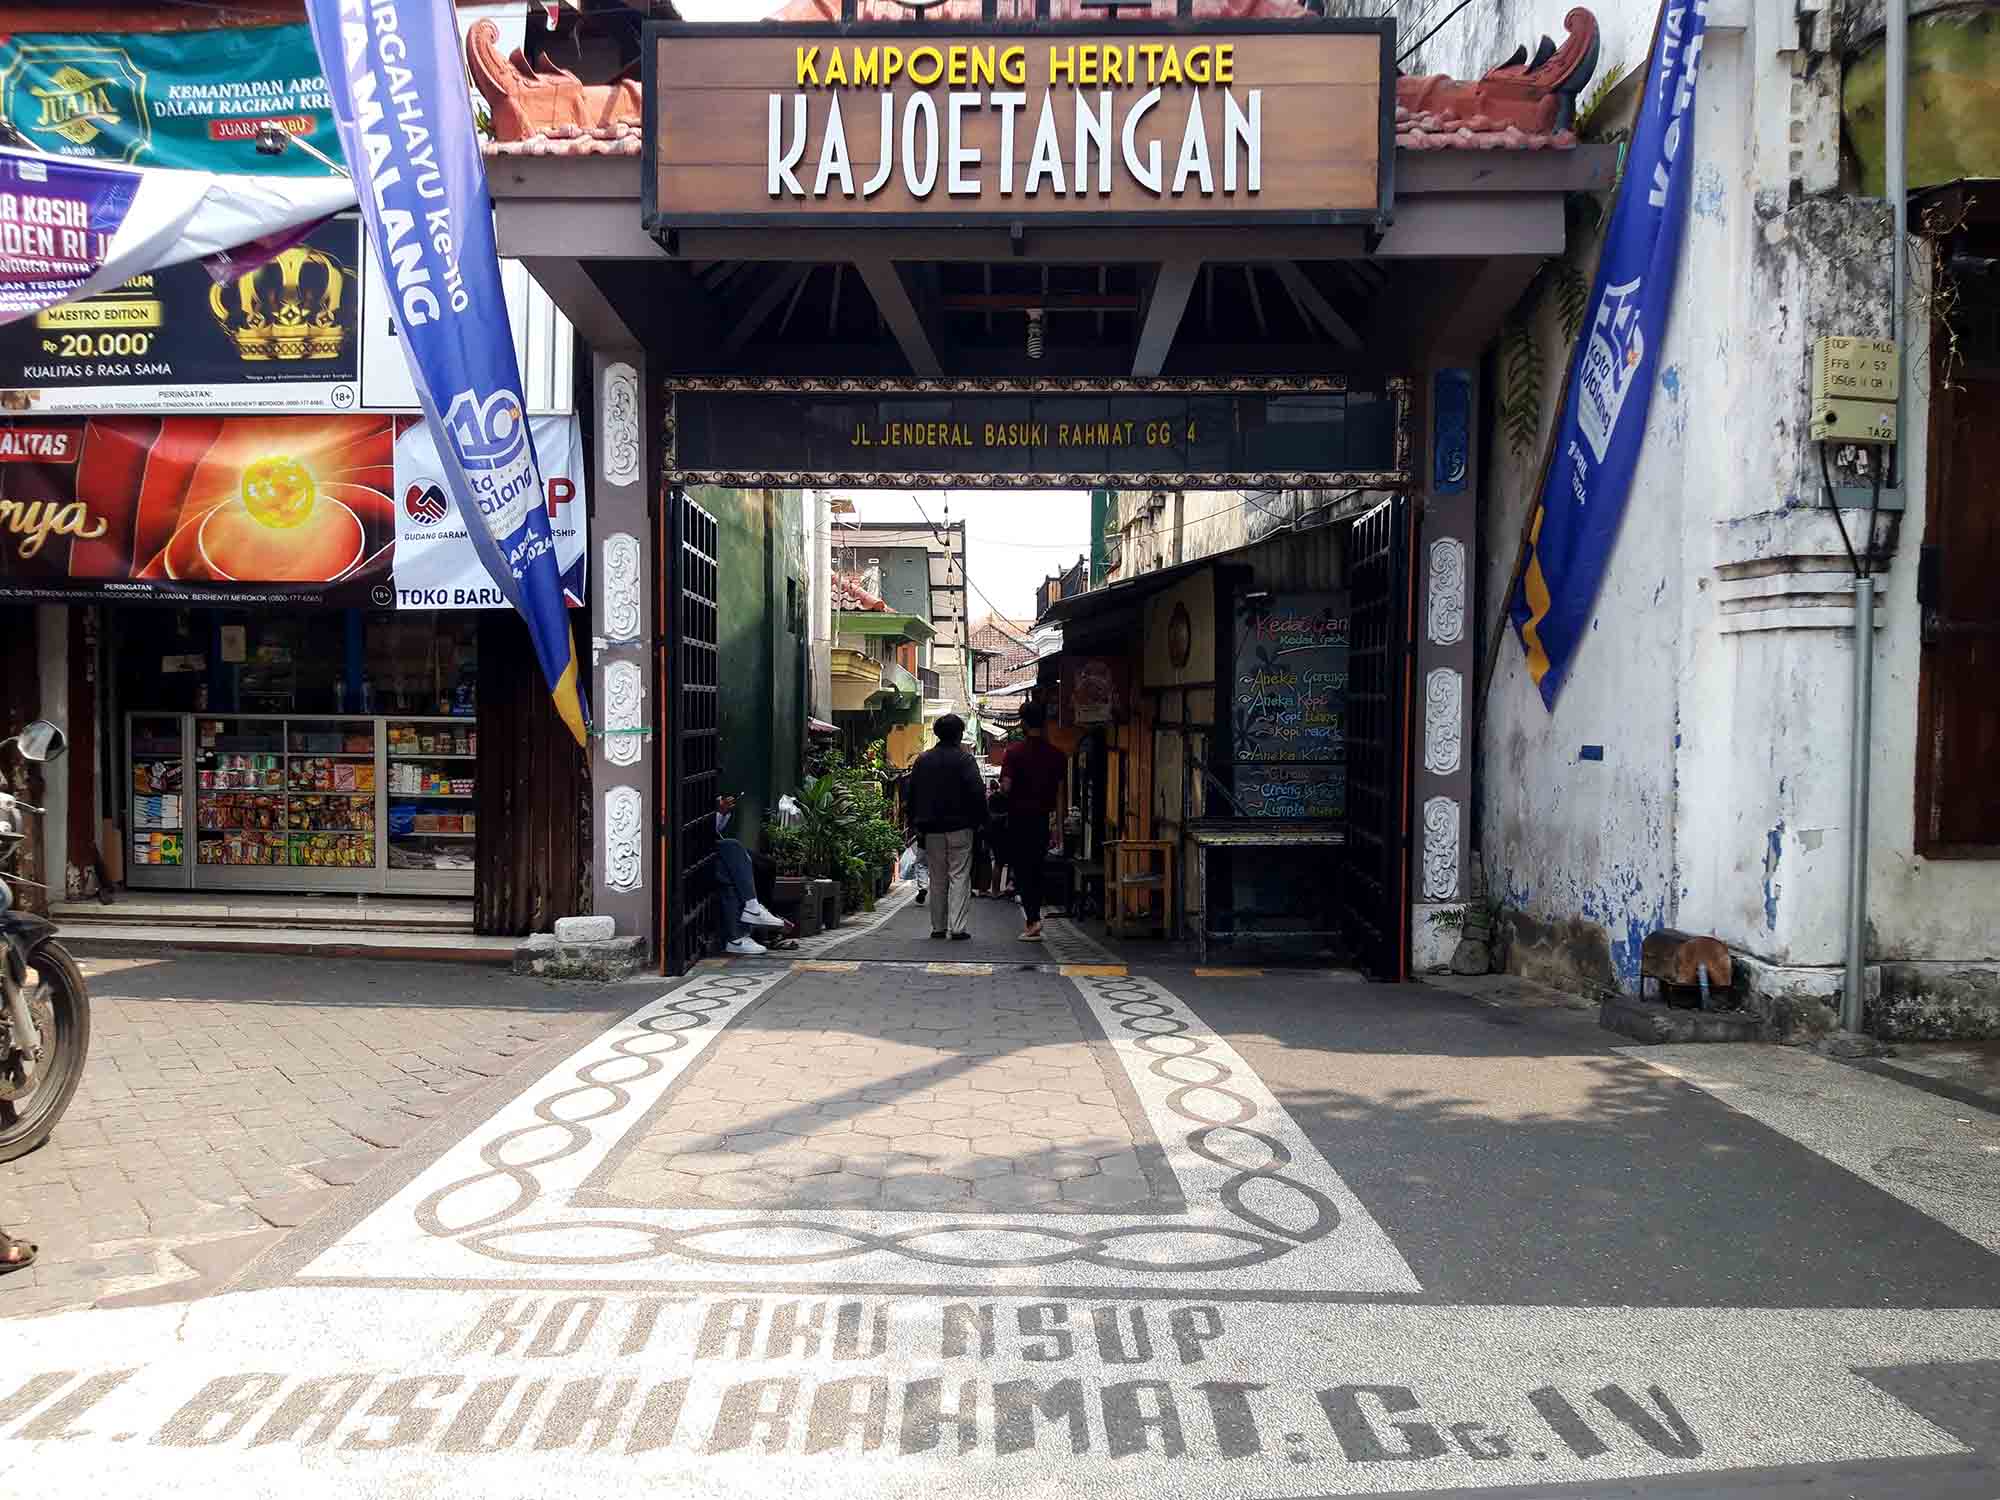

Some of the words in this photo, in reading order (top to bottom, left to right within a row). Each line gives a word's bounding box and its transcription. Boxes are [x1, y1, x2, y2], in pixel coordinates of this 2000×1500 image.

[795, 45, 1026, 86] KAMPOENG
[1050, 43, 1235, 83] HERITAGE
[168, 80, 284, 99] KEMANTAPAN
[370, 0, 444, 199] RGAHAYU
[35, 86, 119, 126] JUARA
[154, 99, 214, 118] DALAM
[220, 96, 294, 115] RACIKAN
[768, 87, 1262, 200] KAJOETANGAN
[352, 70, 440, 327] MALANG
[23, 195, 88, 229] KASIH
[62, 230, 88, 259] RI
[49, 309, 100, 322] MAESTRO
[104, 308, 149, 321] EDITION
[42, 340, 57, 353] Rp
[24, 364, 82, 378] KUALITAS
[85, 365, 94, 376] &
[97, 363, 132, 377] RASA
[134, 362, 173, 376] SAMA
[334, 392, 351, 402] 18+
[984, 423, 1049, 447] BASUKI
[1058, 422, 1134, 447] RAHMAT
[1145, 422, 1171, 446] GG
[1186, 422, 1197, 442] 4
[471, 473, 495, 494] ta
[478, 465, 532, 515] alang
[404, 532, 437, 541] GUDANG
[437, 531, 468, 540] GARAM
[399, 589, 448, 606] TOKO
[453, 587, 504, 605] BARU
[941, 1302, 1227, 1365] NSUP
